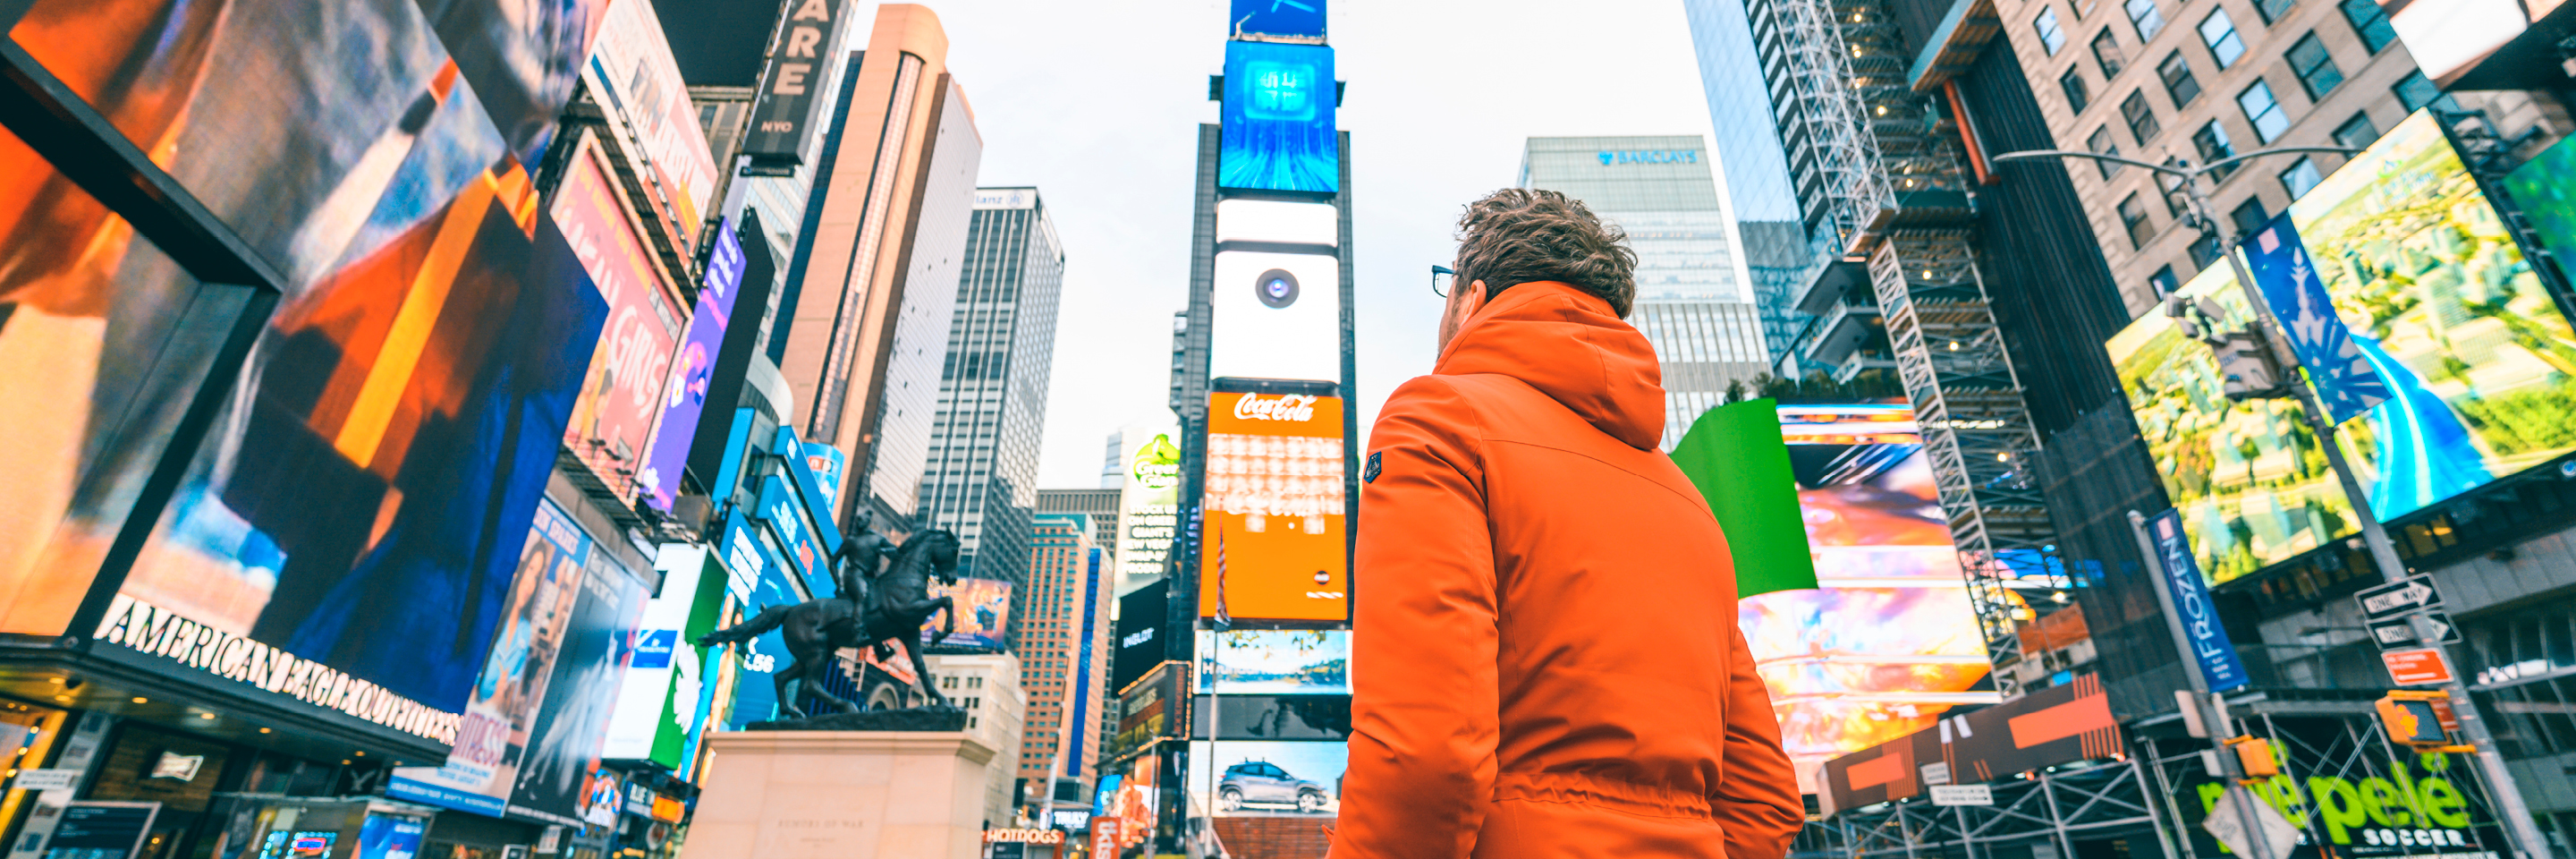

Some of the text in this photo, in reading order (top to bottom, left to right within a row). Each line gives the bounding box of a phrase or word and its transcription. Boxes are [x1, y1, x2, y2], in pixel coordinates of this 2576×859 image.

[1618, 149, 1698, 164] BARCLAYS
[610, 304, 667, 419] GIRLS
[2162, 536, 2224, 659] FROZEN
[93, 591, 283, 691] AMERICAN
[281, 651, 359, 713] EAGLE
[1054, 811, 1089, 825] TRULY
[1096, 821, 1117, 859] tkts
[2362, 829, 2466, 846] SOCCER
